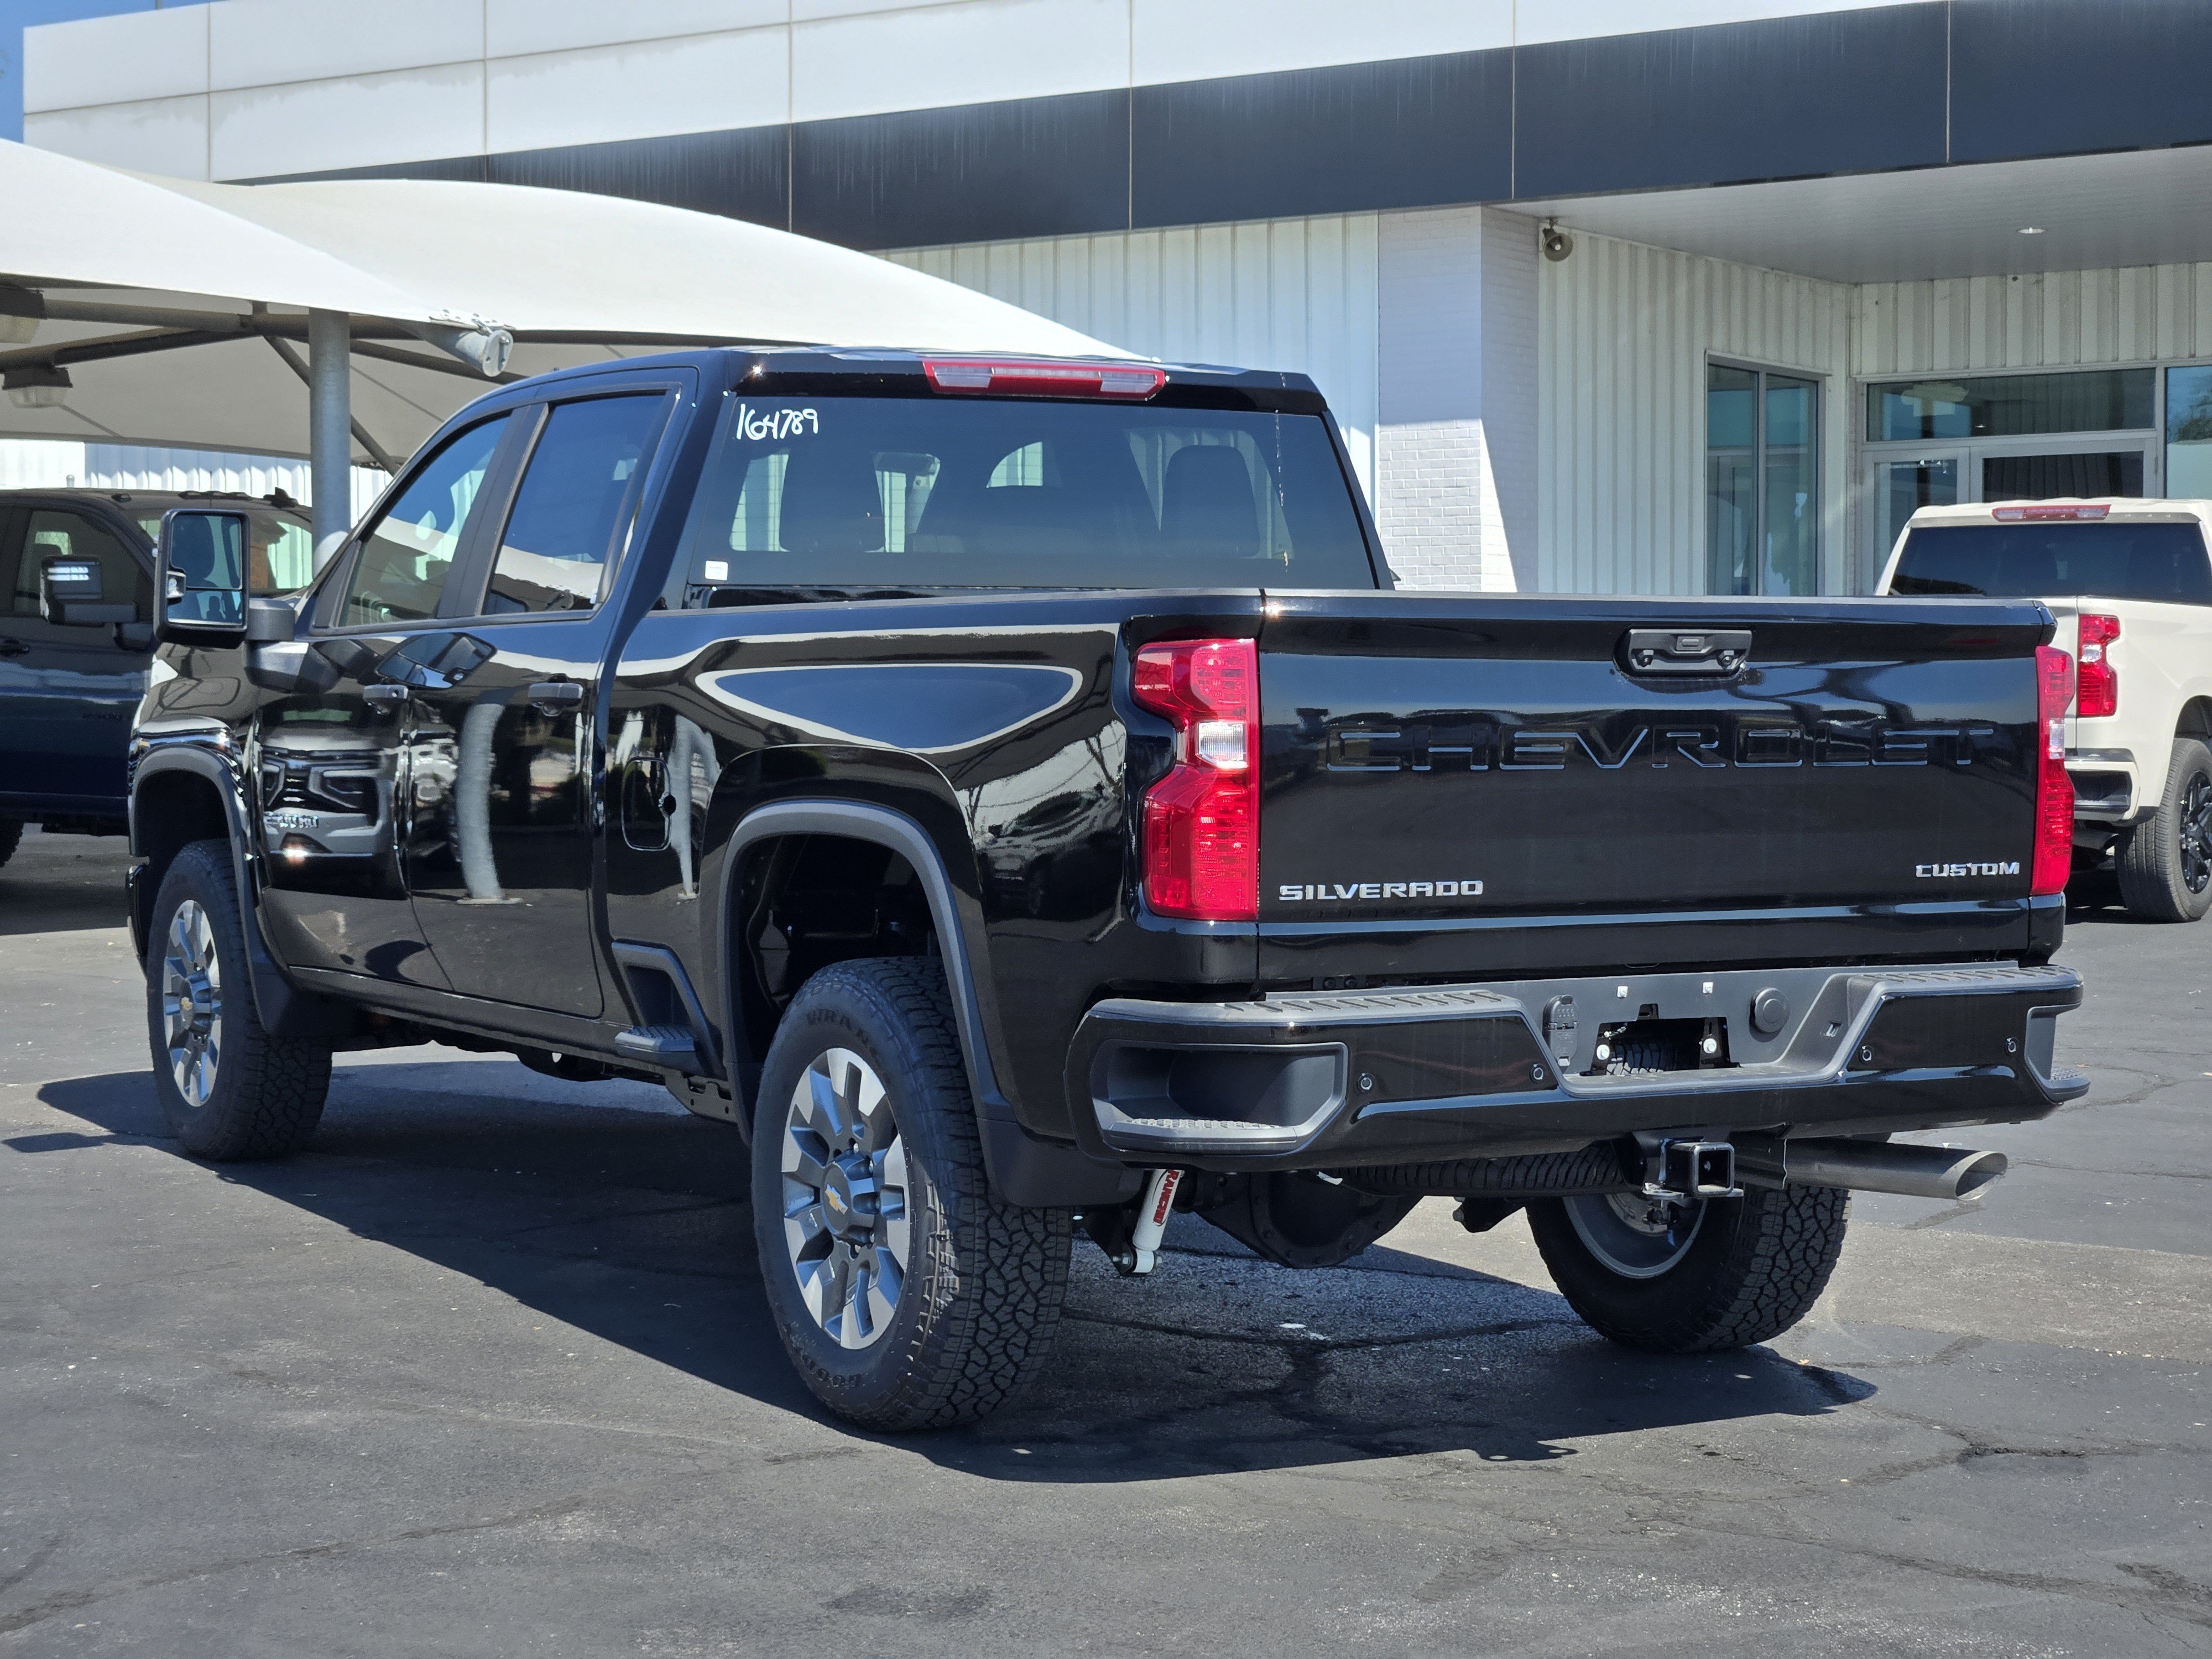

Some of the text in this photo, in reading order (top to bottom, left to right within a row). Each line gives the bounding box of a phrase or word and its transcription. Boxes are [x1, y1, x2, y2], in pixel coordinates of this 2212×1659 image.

[1327, 724, 1994, 771] CHEVROLET
[1916, 862, 2020, 877] CUSTOM
[1279, 880, 1483, 900] SILVERADO
